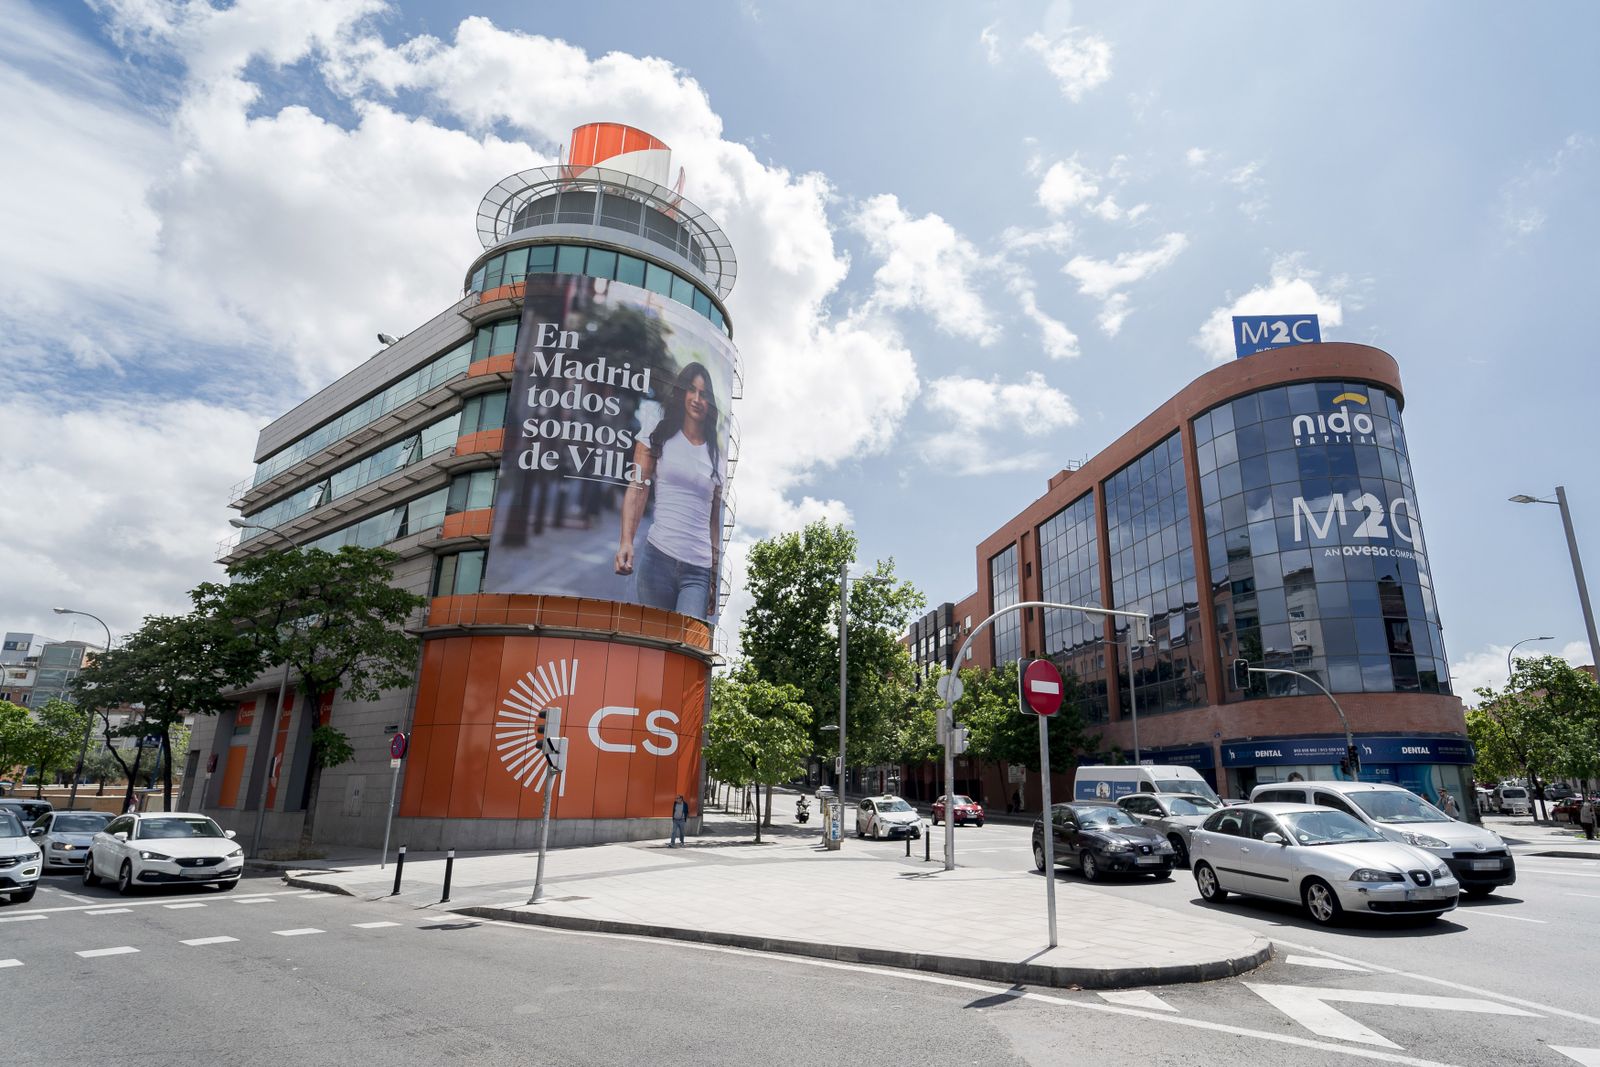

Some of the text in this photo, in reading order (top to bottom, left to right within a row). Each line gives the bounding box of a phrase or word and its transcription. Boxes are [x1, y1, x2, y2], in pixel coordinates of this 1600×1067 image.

[535, 322, 580, 350] En
[1242, 320, 1314, 344] M2C
[529, 351, 651, 394] Madrid
[527, 383, 621, 416] todos
[521, 418, 633, 449] somos
[1292, 405, 1374, 437] nido
[1295, 435, 1376, 446] CAPITAL
[518, 442, 652, 487] de Villa.
[1292, 492, 1415, 542] M2C
[1324, 546, 1416, 560] AN ayesa COMPA
[588, 706, 680, 756] CS
[1255, 749, 1283, 758] DENTAL
[1401, 746, 1431, 755] DENTAL
